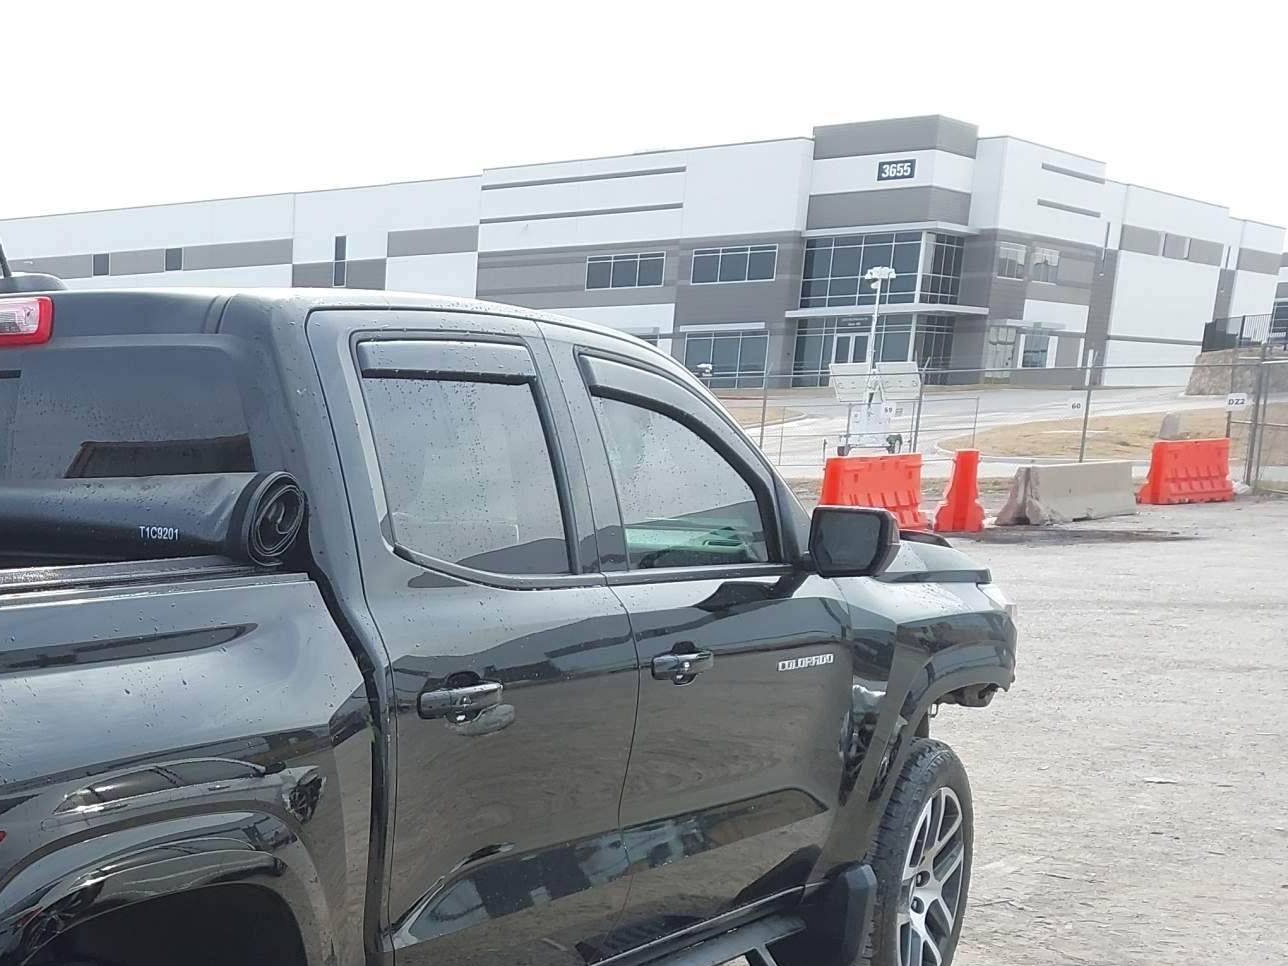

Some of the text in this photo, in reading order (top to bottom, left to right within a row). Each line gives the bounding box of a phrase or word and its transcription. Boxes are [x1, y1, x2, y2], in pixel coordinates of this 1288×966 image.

[881, 162, 912, 178] 3655
[1227, 398, 1246, 406] DZ2
[139, 526, 179, 540] T1C9201
[778, 653, 834, 672] COLORADO
